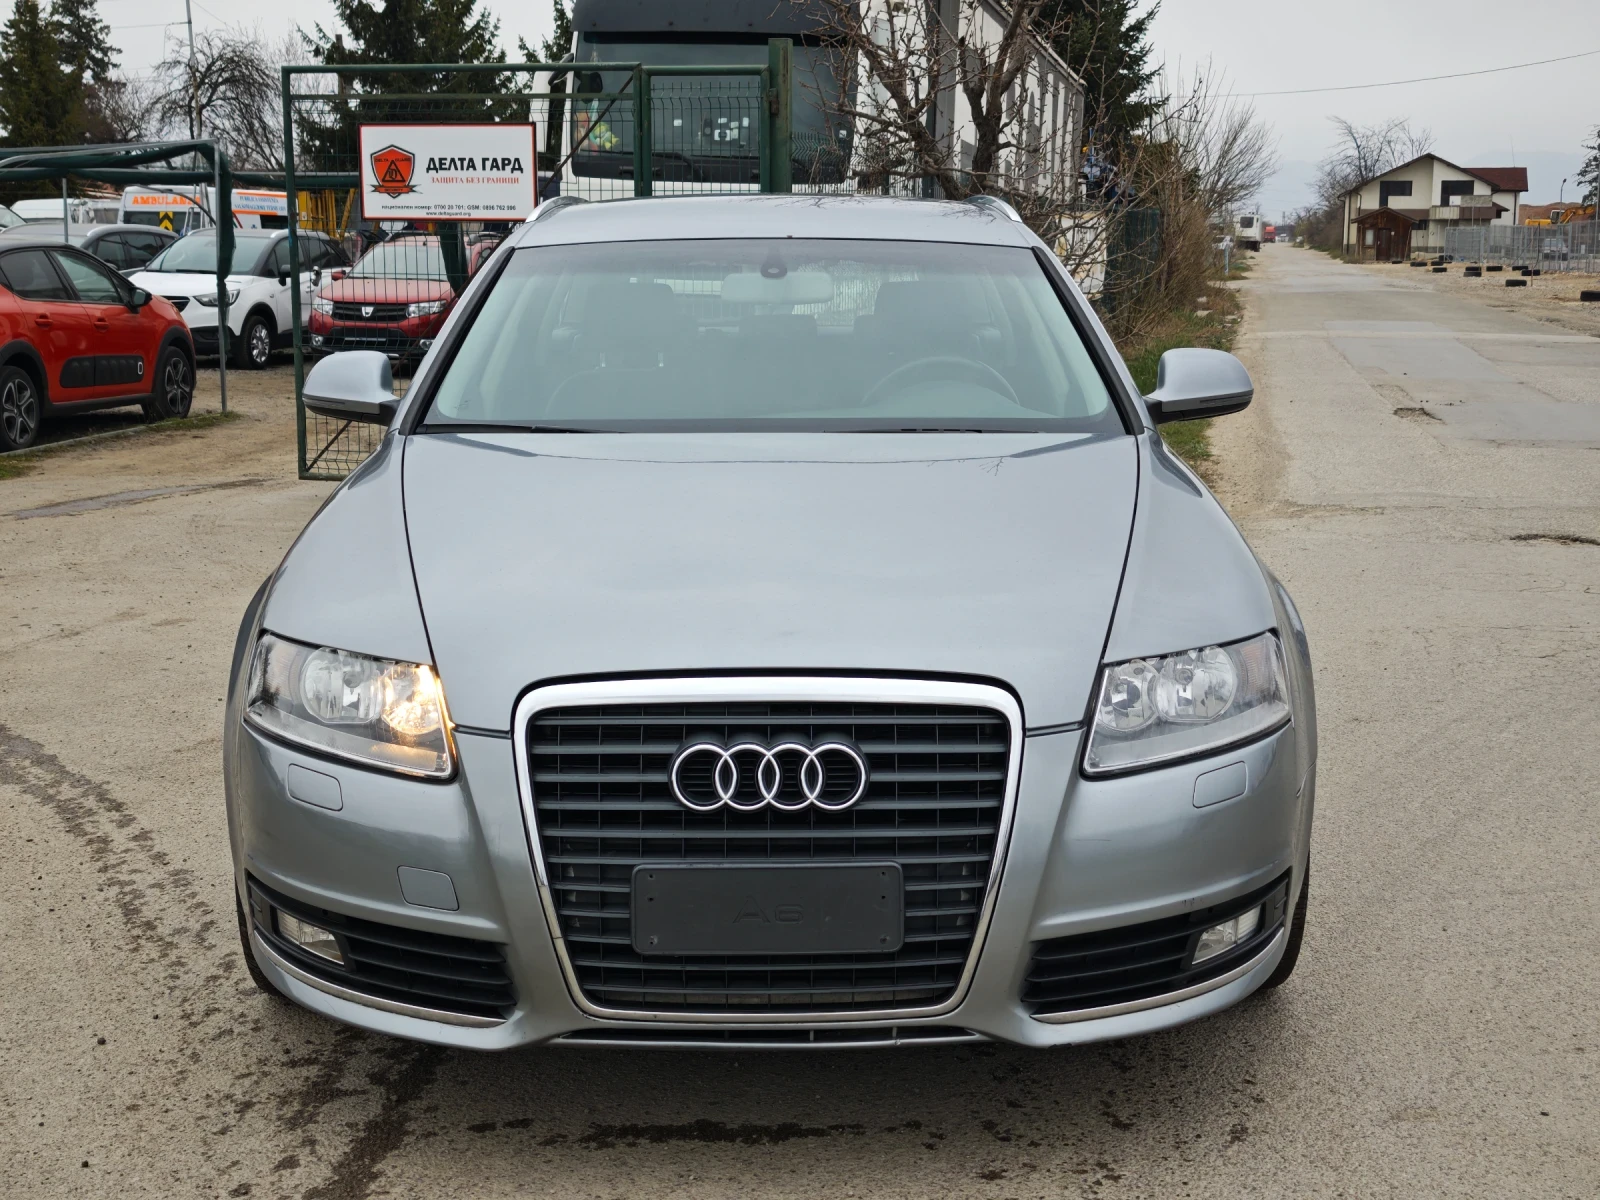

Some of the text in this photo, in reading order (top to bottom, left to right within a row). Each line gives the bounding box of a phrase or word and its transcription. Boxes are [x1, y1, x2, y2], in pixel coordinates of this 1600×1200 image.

[426, 157, 524, 174] ДЕЛТА ГАРД
[431, 176, 519, 185] ЗАЩИТА БЕЗ ГРАНИЦИ
[732, 895, 804, 924] A6
